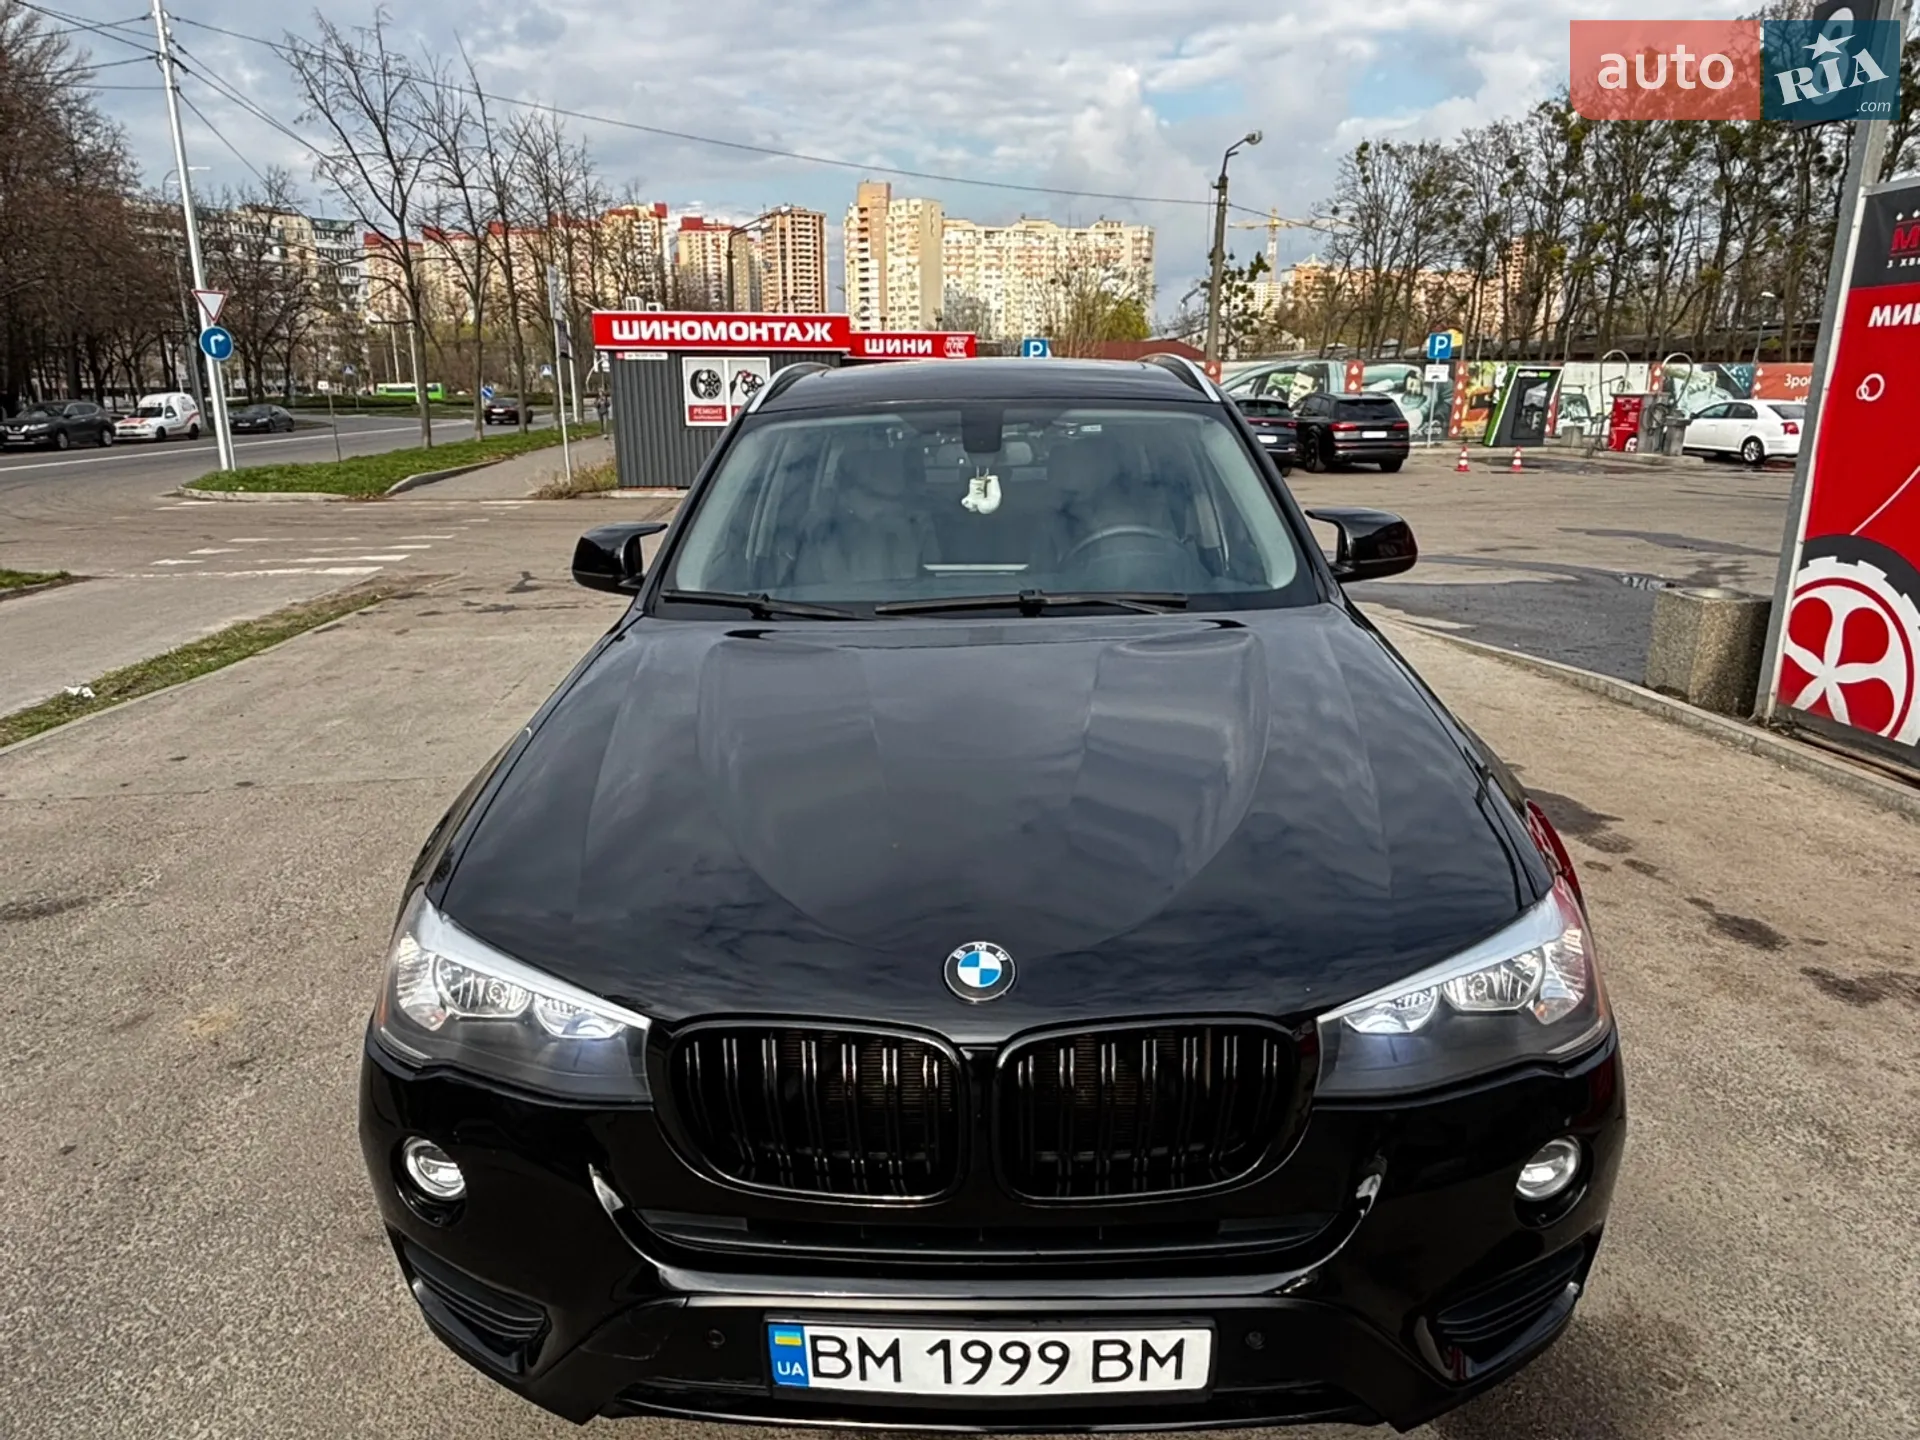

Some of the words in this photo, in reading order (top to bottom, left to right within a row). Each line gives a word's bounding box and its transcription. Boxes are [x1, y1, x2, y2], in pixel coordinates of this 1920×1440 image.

[611, 320, 833, 342] ШИНОМОНТАЖ
[864, 338, 932, 354] ШИНИ
[1029, 342, 1043, 358] P
[1434, 335, 1448, 356] P
[952, 942, 1008, 961] BMW
[778, 1361, 804, 1376] UA
[810, 1335, 901, 1383] BM
[925, 1338, 1070, 1385] 1999
[1092, 1337, 1186, 1383] BM
